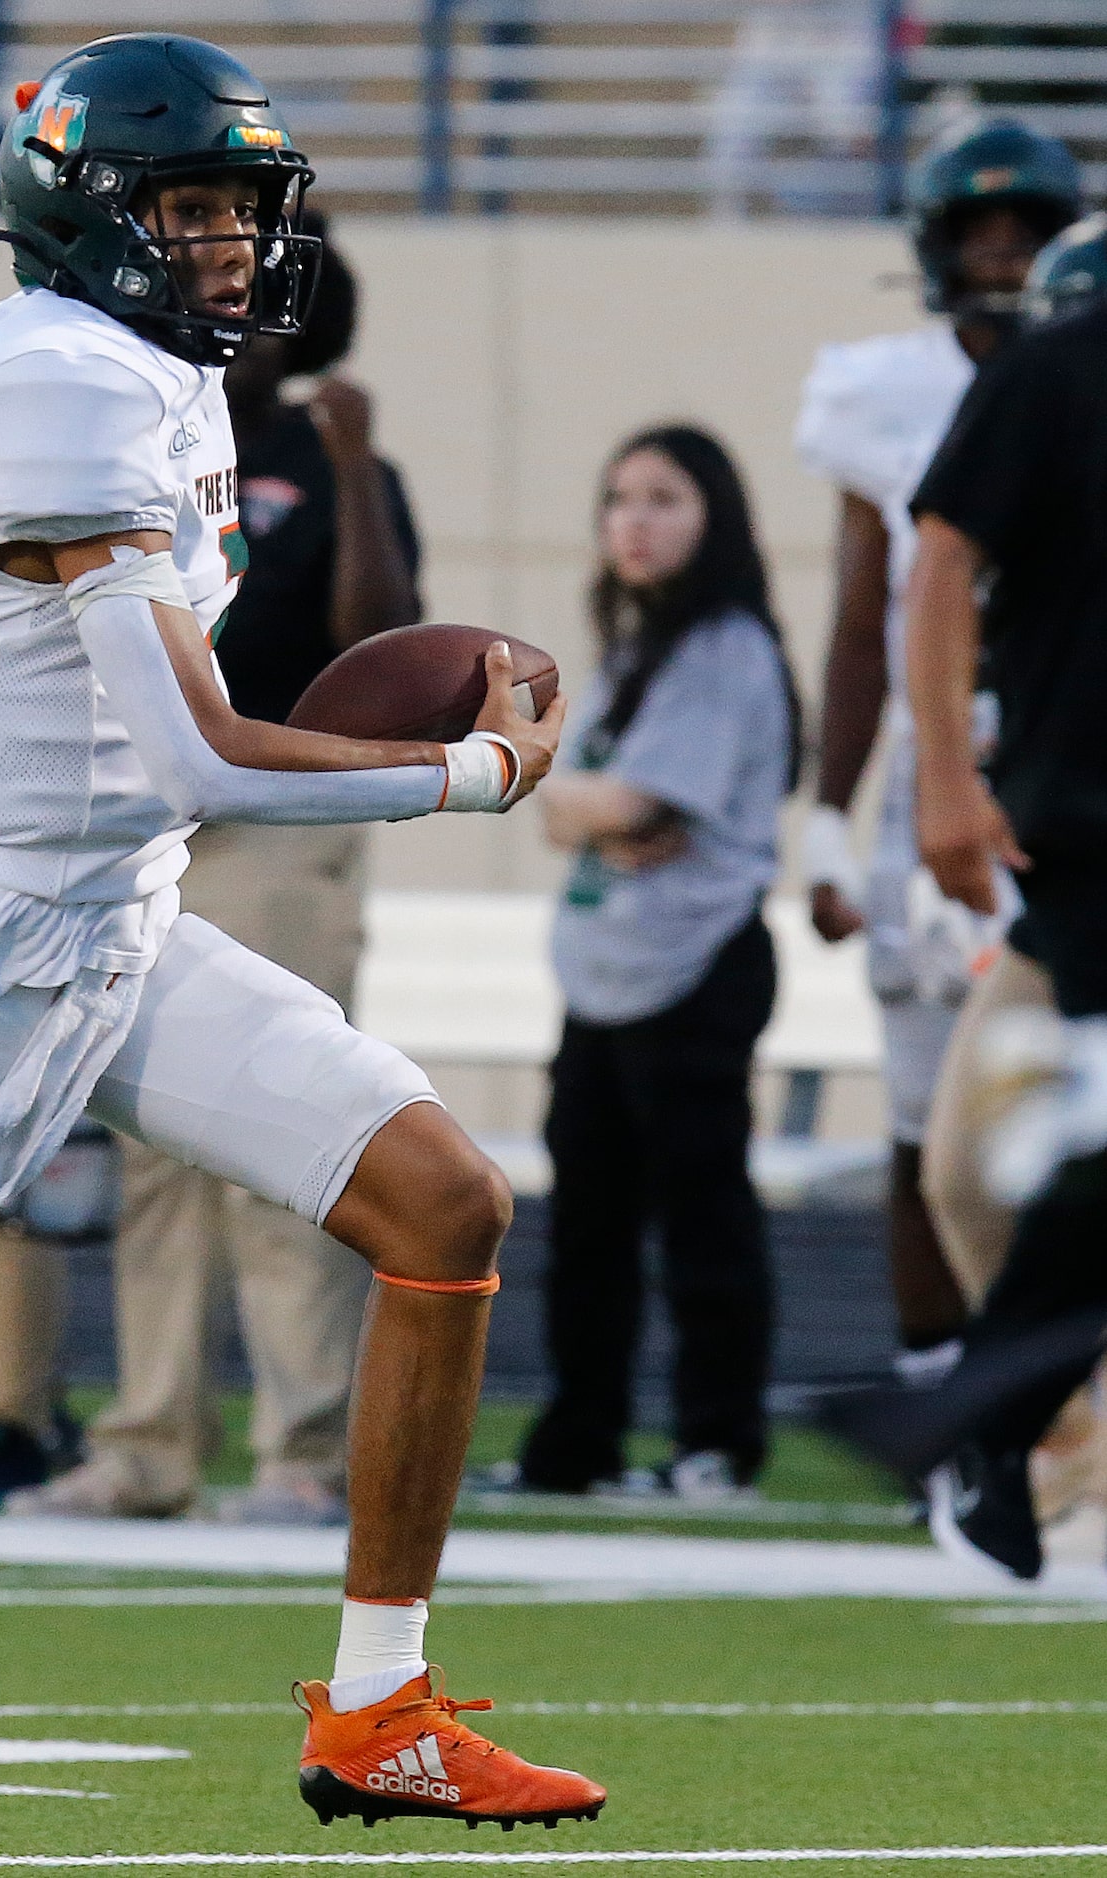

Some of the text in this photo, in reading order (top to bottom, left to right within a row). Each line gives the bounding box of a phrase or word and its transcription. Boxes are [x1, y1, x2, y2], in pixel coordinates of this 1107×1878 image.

[36, 106, 75, 152] N
[194, 471, 223, 516] THE
[366, 1772, 461, 1803] adidas
